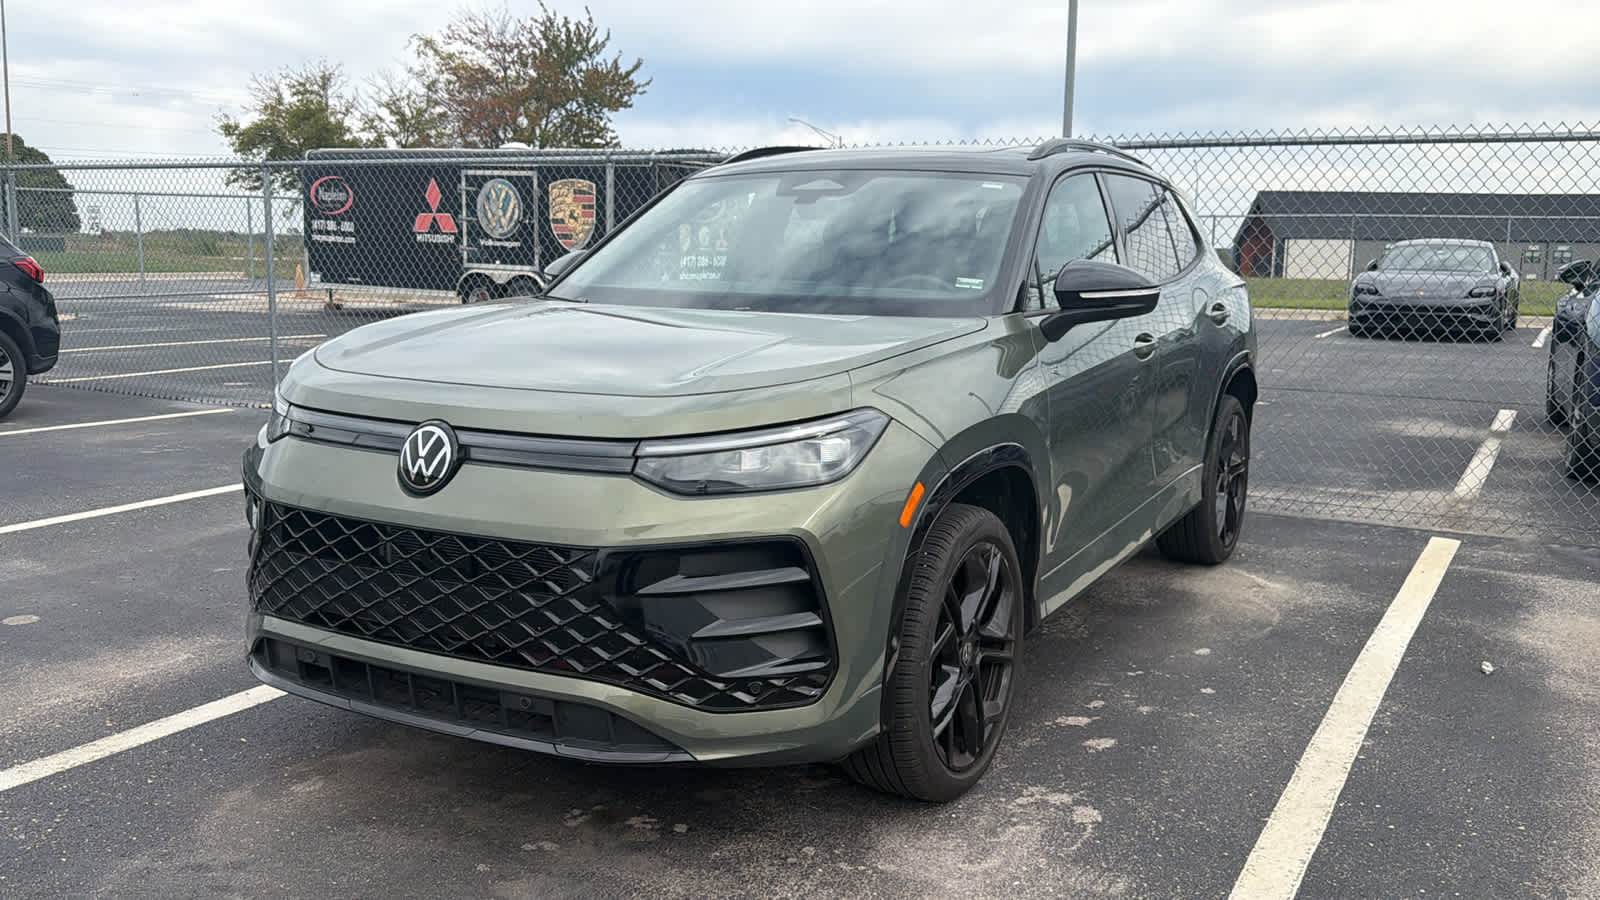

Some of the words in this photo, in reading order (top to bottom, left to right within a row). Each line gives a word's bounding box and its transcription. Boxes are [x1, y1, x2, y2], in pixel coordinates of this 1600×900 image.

[416, 234, 455, 243] MITSUBISHI
[480, 239, 521, 248] Volkswagen
[402, 427, 450, 484] VW
